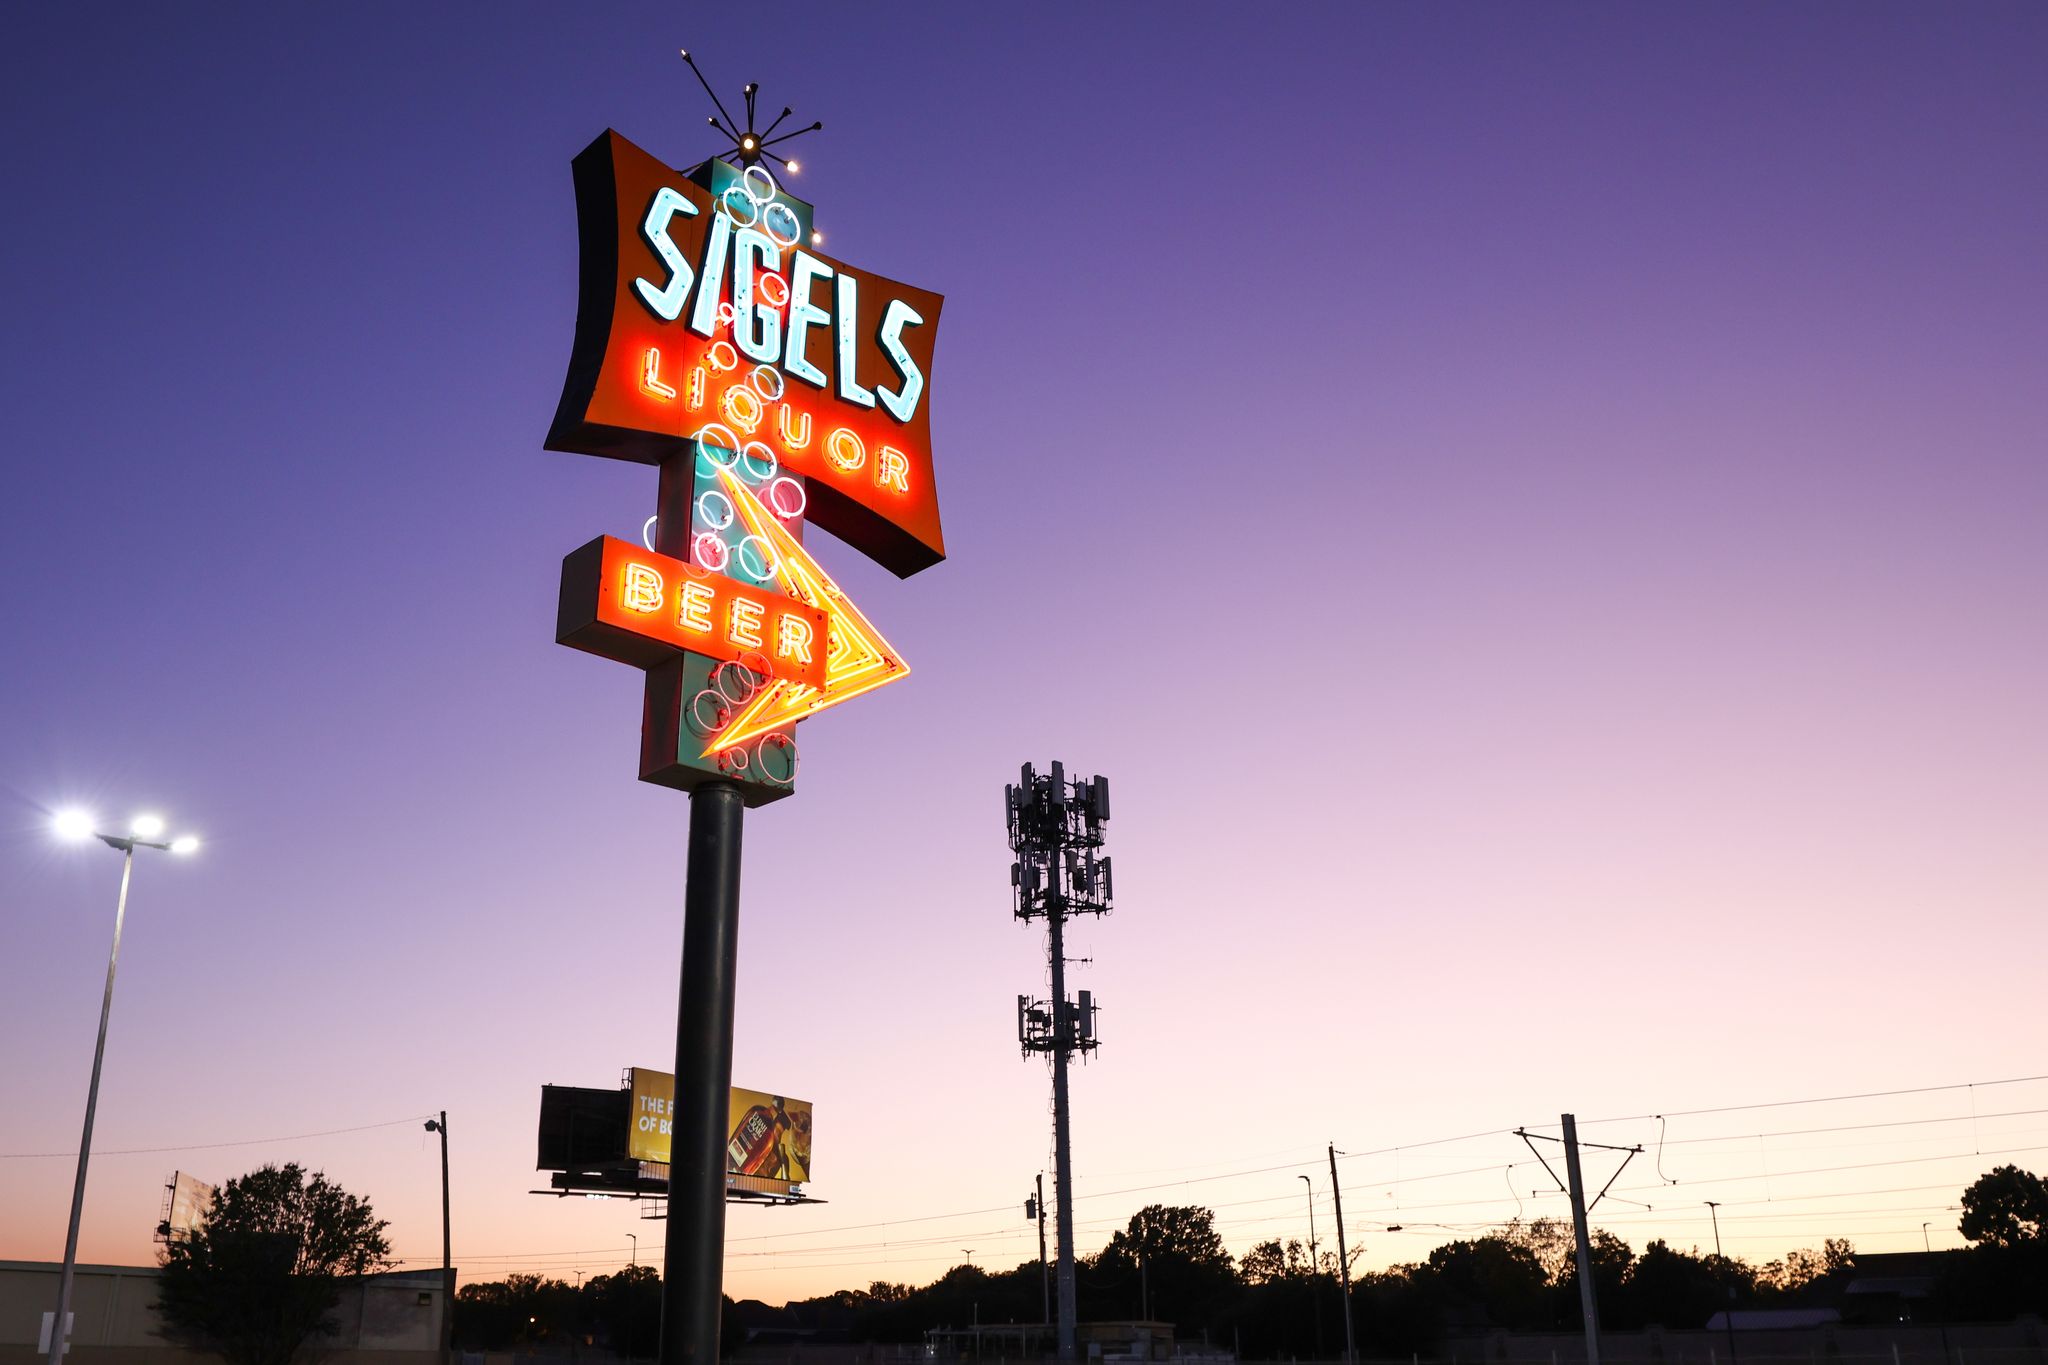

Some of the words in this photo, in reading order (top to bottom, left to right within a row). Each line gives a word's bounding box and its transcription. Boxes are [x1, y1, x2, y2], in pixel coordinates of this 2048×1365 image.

[635, 186, 925, 424] SIGELS
[639, 347, 910, 495] LIQUOR
[618, 562, 814, 666] BEER
[638, 1115, 657, 1132] OF
[640, 1096, 664, 1114] THE
